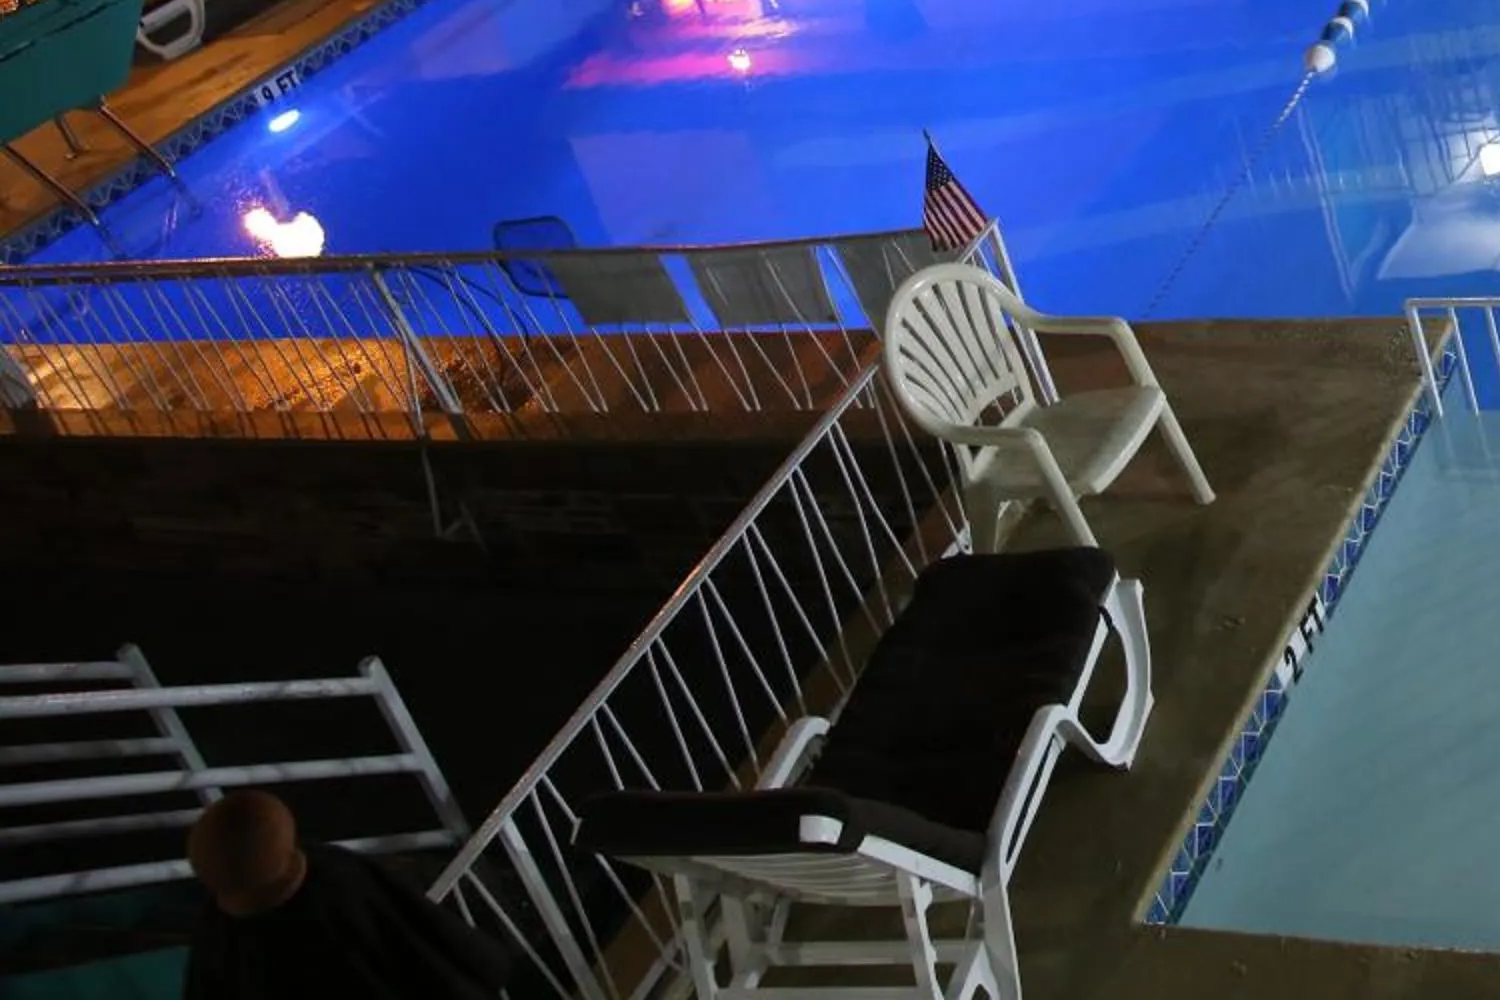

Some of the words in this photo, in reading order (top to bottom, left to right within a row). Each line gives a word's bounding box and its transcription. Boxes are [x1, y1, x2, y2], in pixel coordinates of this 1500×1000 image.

[261, 85, 275, 104] 9
[275, 70, 297, 95] FT
[1284, 645, 1304, 686] 2
[1299, 594, 1324, 654] FT
